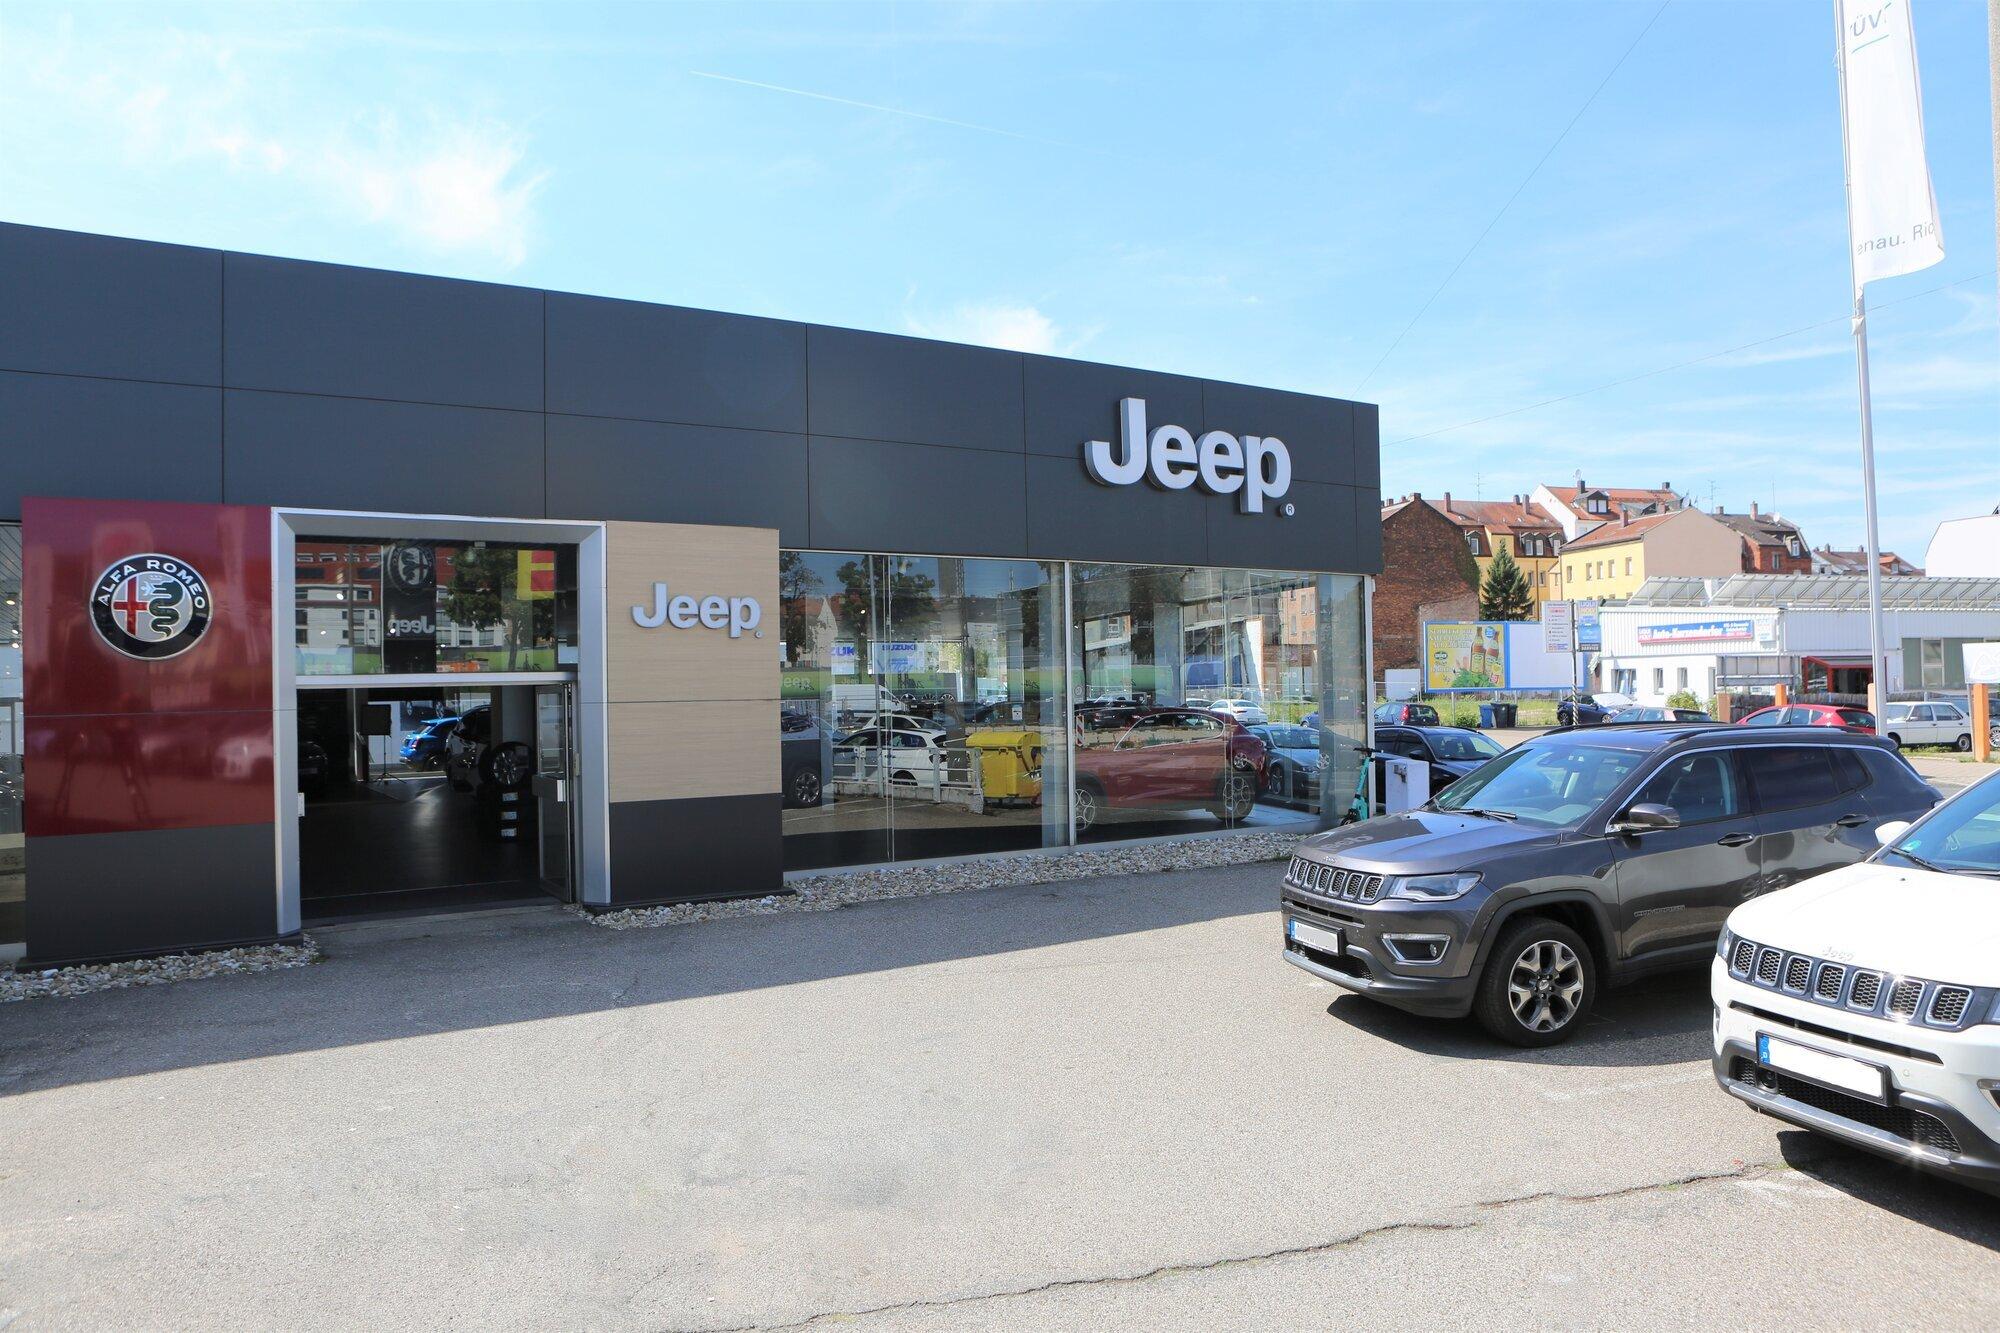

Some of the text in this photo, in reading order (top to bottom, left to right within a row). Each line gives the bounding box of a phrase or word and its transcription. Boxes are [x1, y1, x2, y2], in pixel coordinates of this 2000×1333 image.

[1084, 397, 1292, 514] Jeep
[98, 560, 206, 609] ALFA ROMEO
[631, 582, 761, 638] Jeep
